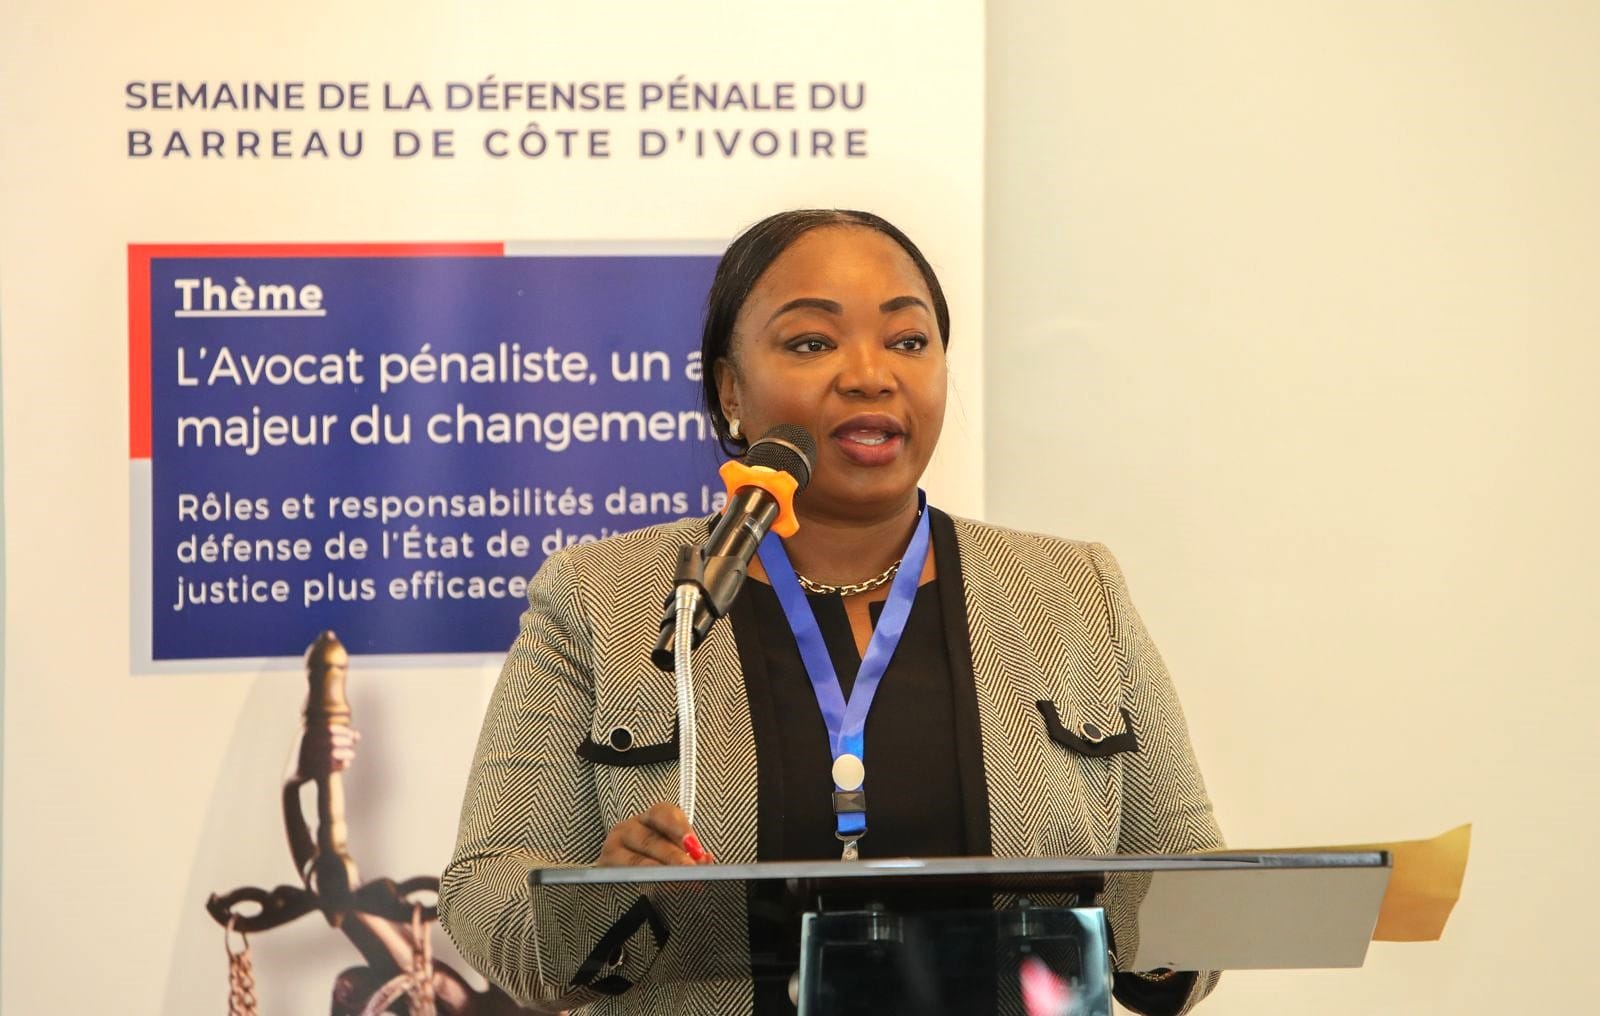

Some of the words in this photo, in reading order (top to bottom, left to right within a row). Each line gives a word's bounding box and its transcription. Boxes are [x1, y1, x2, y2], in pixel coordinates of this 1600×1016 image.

[125, 81, 304, 110] SEMAINE
[319, 81, 369, 110] DE
[384, 81, 431, 110] LA
[446, 75, 625, 110] DÉFENSE
[641, 74, 795, 110] PÉNALE
[810, 82, 865, 110] DU
[127, 130, 364, 158] BARREAU
[394, 129, 455, 158] DE
[484, 121, 610, 158] CÔTE
[641, 129, 868, 158] D'IVOIRE
[175, 276, 326, 317] Thème
[177, 346, 364, 386] L'Avocat
[380, 343, 597, 393] pénaliste,
[612, 351, 670, 382] un
[177, 406, 337, 456] majeur
[351, 404, 411, 445] du
[178, 492, 270, 522] Rôles
[282, 494, 315, 519] et
[329, 487, 593, 524] responsabilités
[605, 487, 688, 514] dans
[701, 485, 727, 513] la
[177, 534, 312, 563] défense
[325, 532, 368, 559] de
[382, 525, 474, 559] l'État
[487, 529, 529, 557] de
[173, 575, 290, 611] justice
[304, 573, 376, 607] plus
[389, 571, 528, 600] efficace
